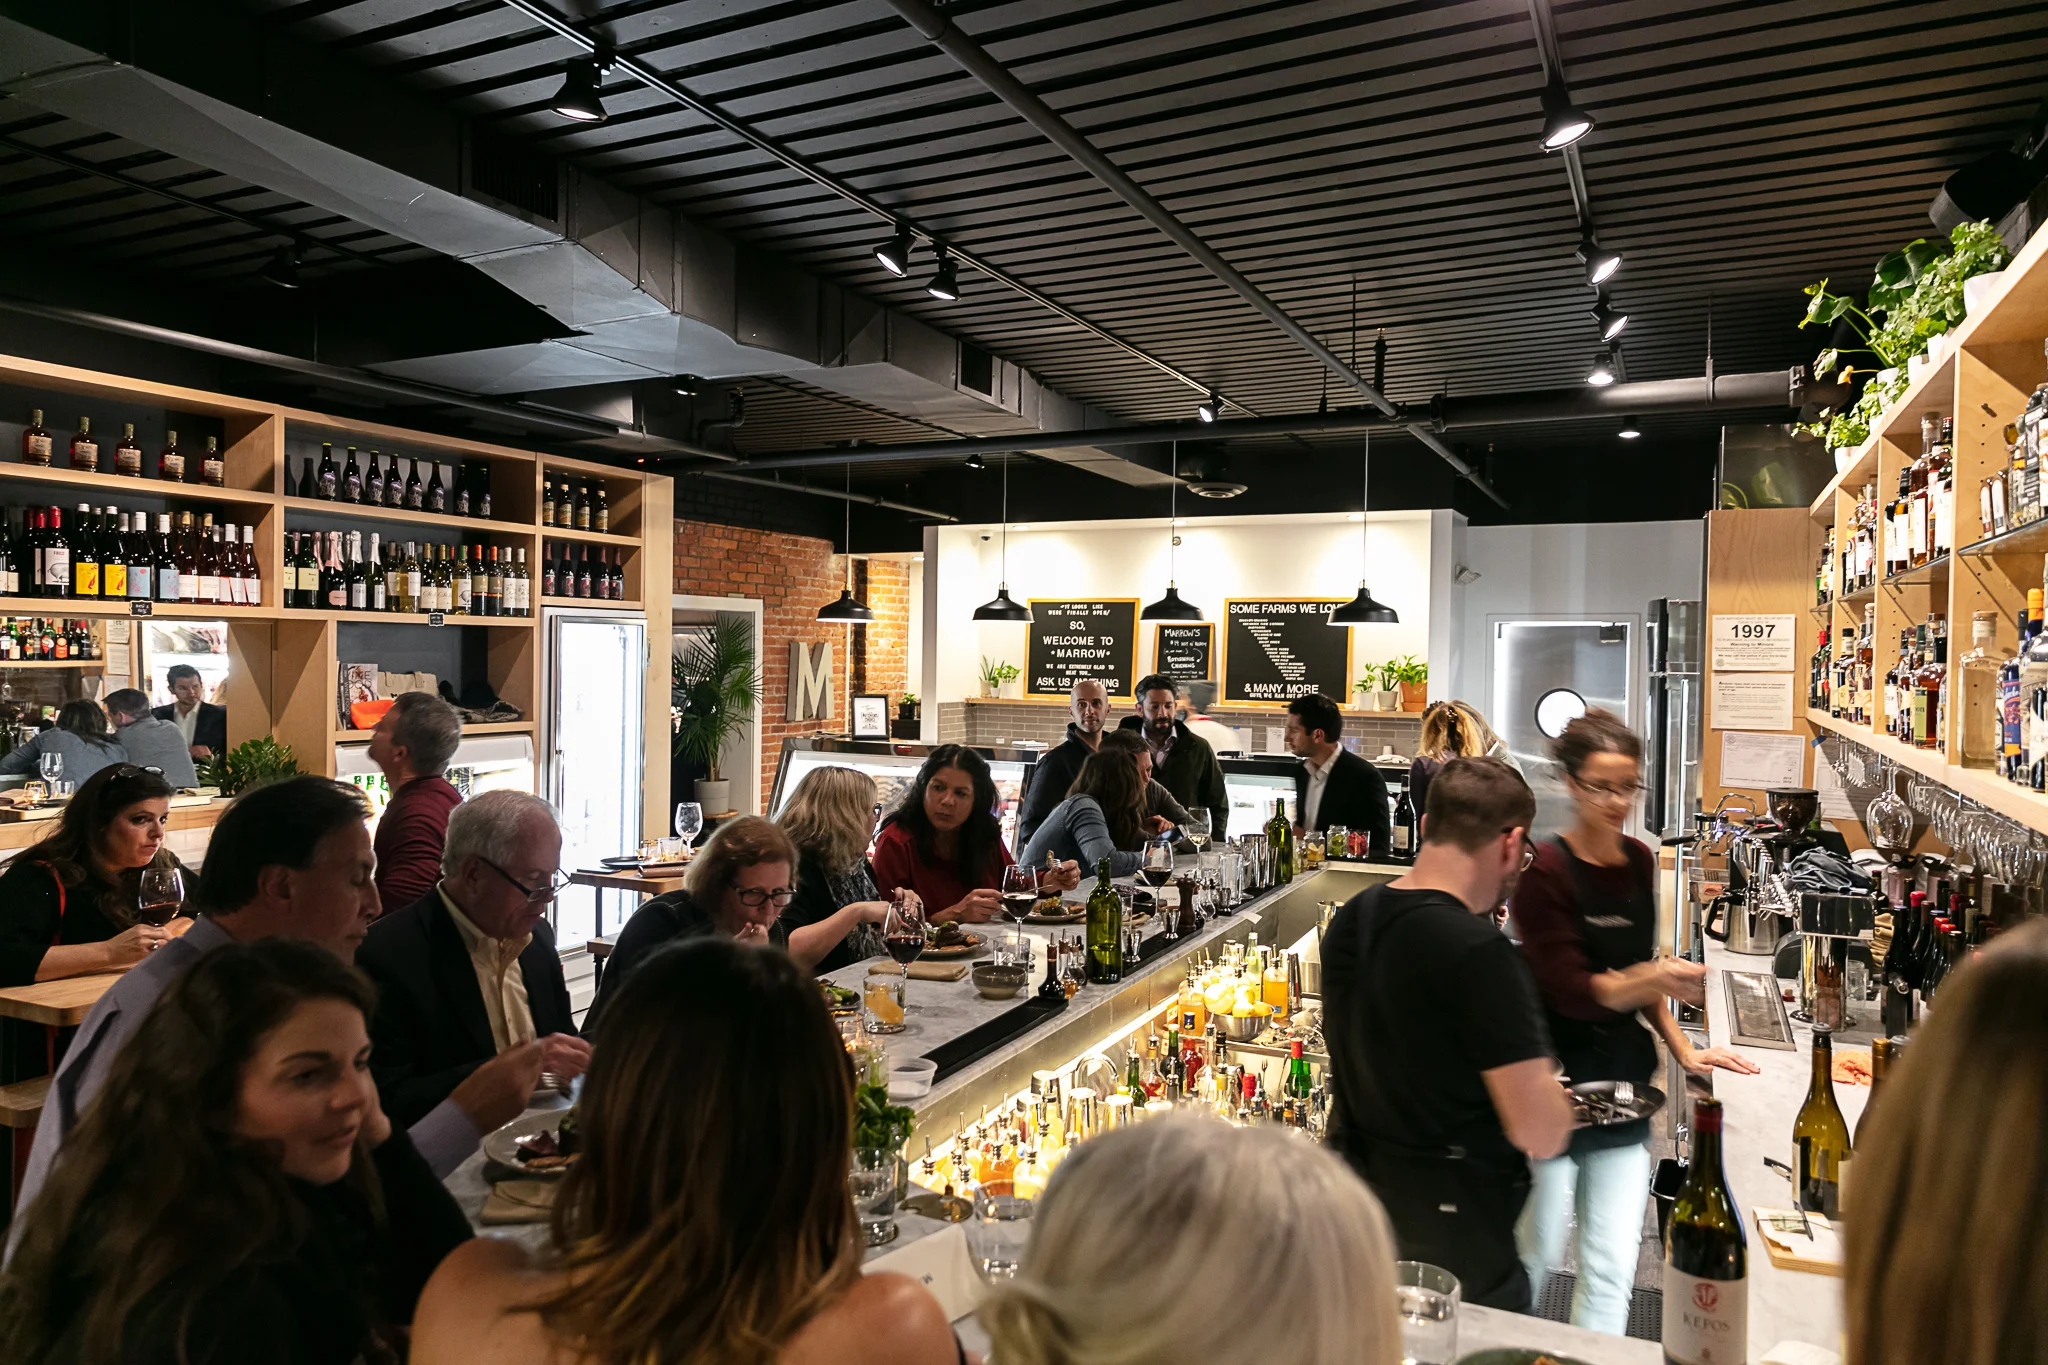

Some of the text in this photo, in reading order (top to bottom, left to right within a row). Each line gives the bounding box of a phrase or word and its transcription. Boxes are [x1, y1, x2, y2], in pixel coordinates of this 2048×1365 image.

[1230, 604, 1345, 614] SOME FARMS WE LOV
[1070, 621, 1086, 631] SO,
[1731, 624, 1776, 638] 1997
[1165, 629, 1200, 637] MARROW'S
[1043, 636, 1113, 645] WELCOME TO
[1057, 649, 1105, 658] MARROW
[1036, 677, 1119, 687] ASK US AHING
[1244, 683, 1319, 694] & MANY MORE
[1683, 1312, 1730, 1331] KEPOS
